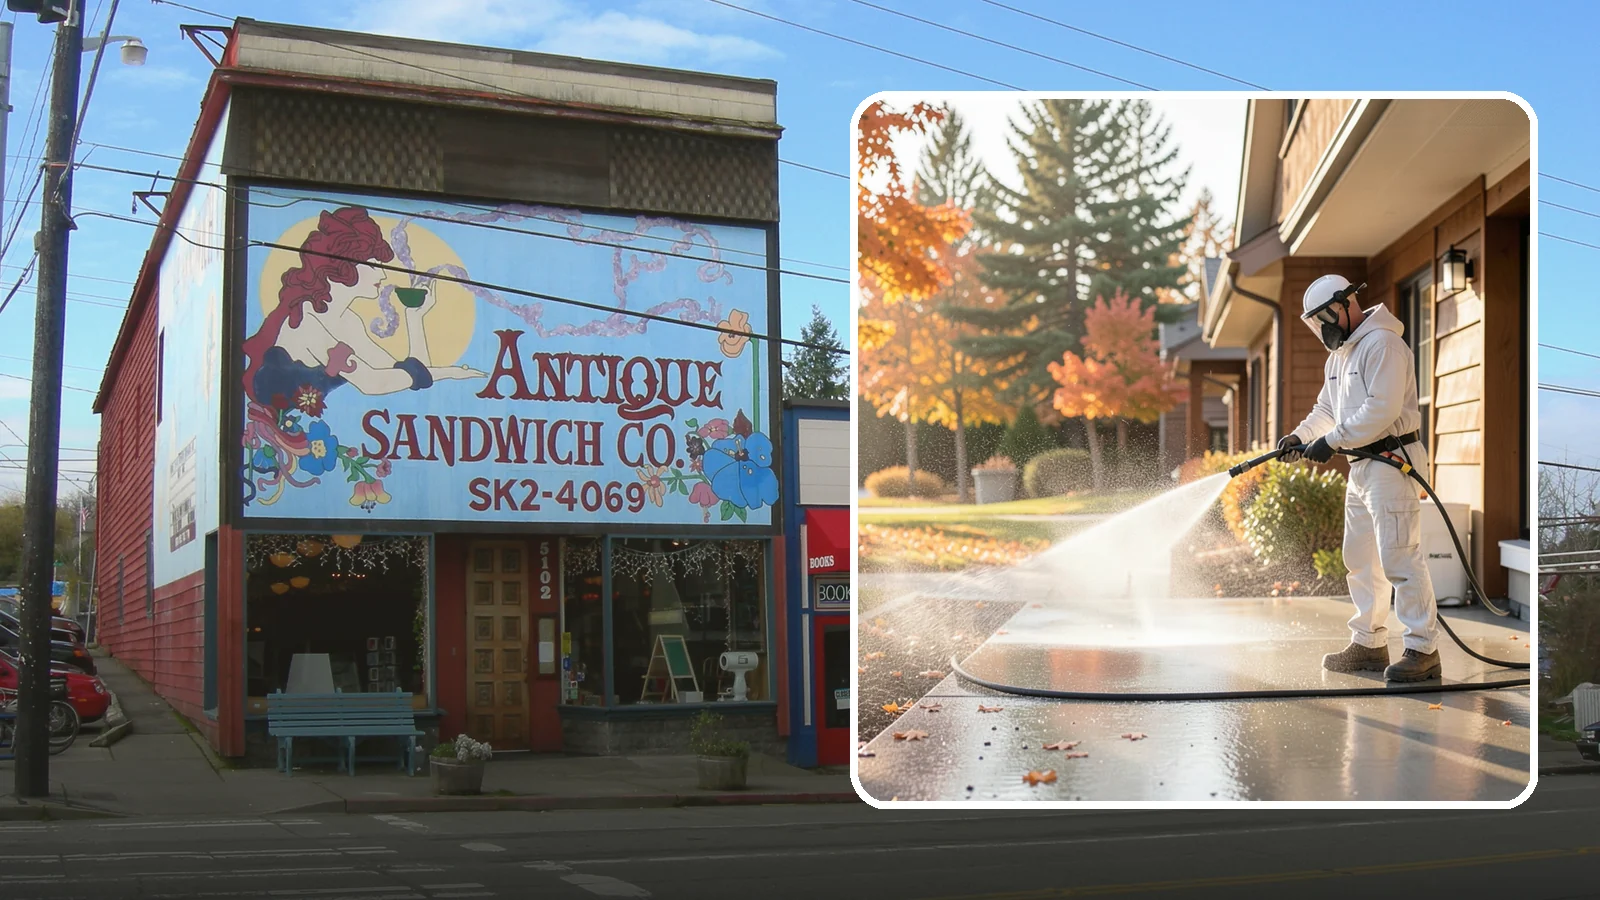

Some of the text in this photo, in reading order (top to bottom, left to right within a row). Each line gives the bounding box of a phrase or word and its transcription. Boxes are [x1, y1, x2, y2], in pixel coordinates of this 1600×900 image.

[476, 329, 724, 420] ANTIQUE
[361, 409, 685, 468] SANDWICH CO.
[468, 477, 645, 512] SK2-4069
[540, 542, 551, 599] 5102
[809, 555, 835, 569] BOOKS
